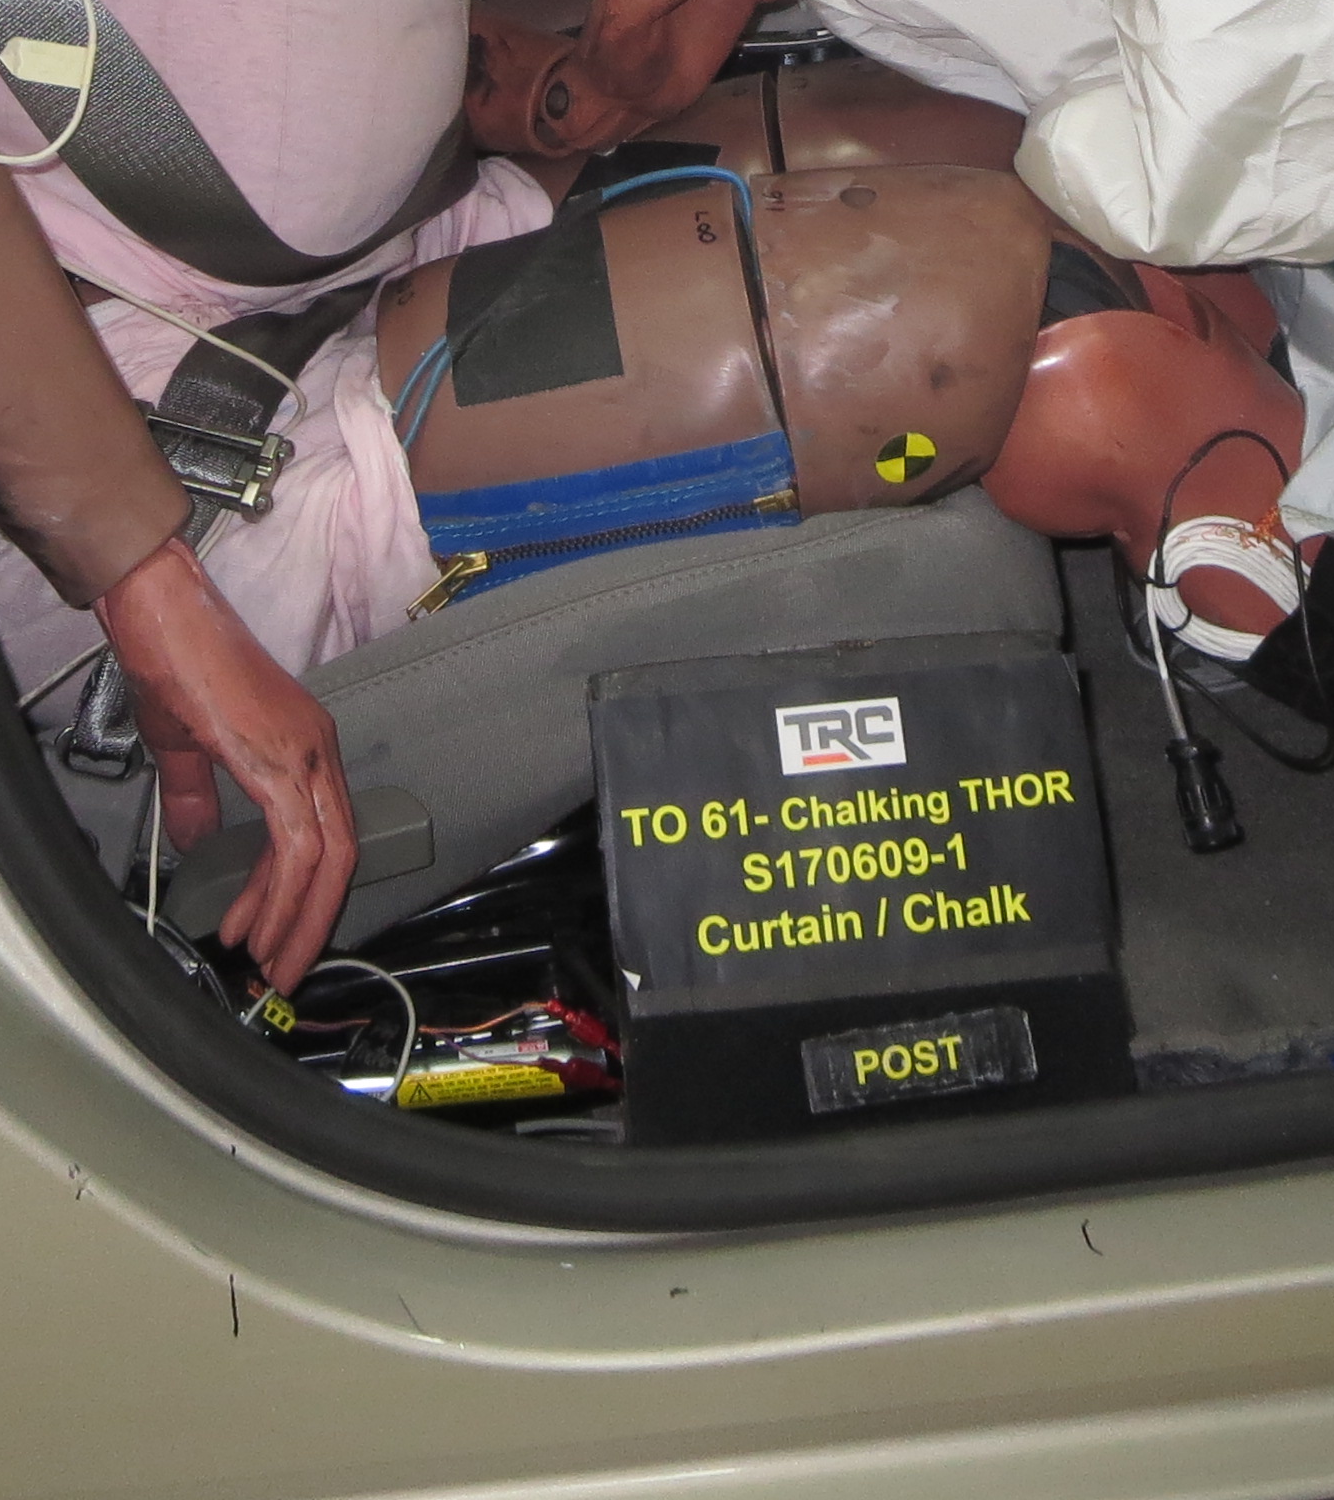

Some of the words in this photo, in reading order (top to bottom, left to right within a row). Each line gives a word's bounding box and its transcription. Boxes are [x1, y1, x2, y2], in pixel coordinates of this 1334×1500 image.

[783, 705, 895, 761] TRC
[621, 804, 688, 847] TO
[701, 797, 769, 840] 61-
[780, 787, 951, 832] Chalking
[958, 769, 1075, 813] THOR
[742, 832, 968, 893] S170609-1
[697, 904, 863, 956] Curtain
[876, 897, 888, 937] /
[902, 884, 1031, 934] Chalk
[854, 1035, 963, 1085] POST
